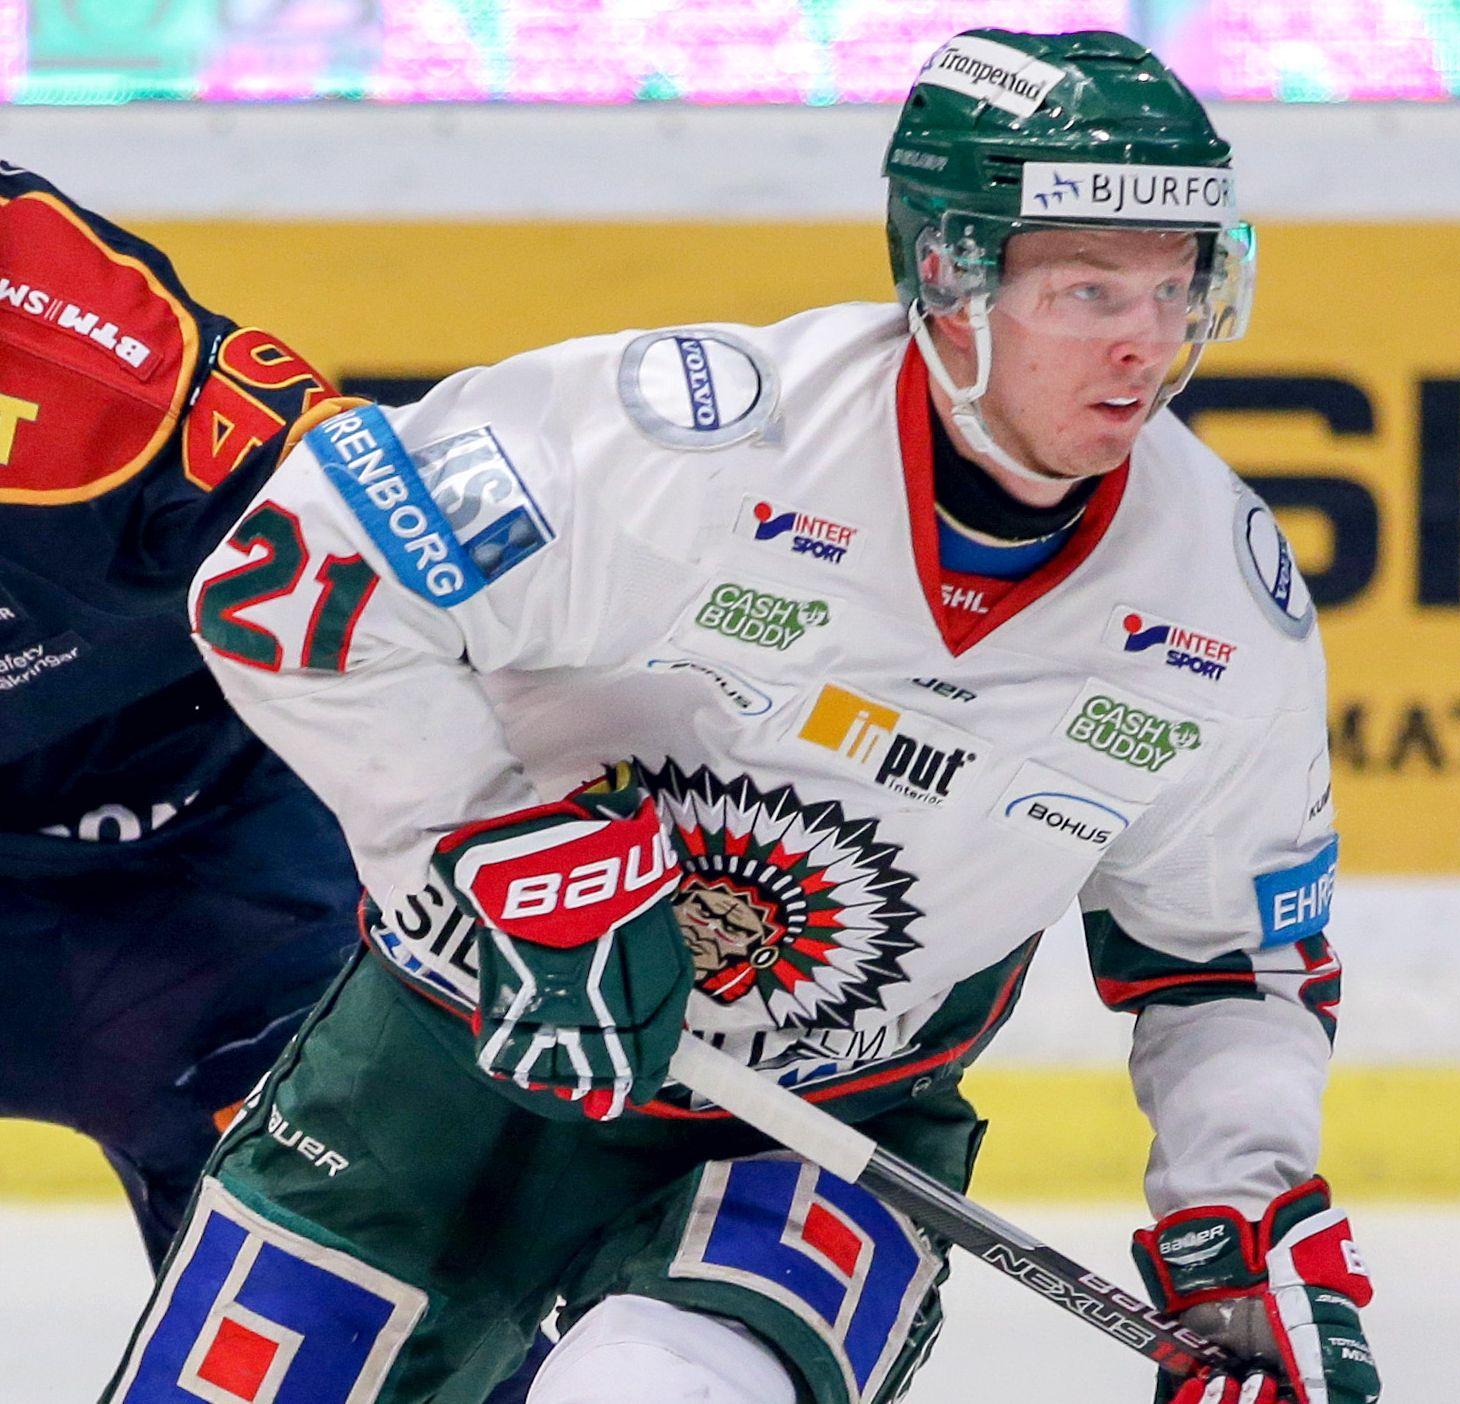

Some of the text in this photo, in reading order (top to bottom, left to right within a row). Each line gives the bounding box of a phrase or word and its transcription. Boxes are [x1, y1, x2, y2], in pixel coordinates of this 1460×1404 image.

[681, 338, 716, 427] VOLVO
[791, 535, 848, 565] SPORT
[794, 512, 855, 546] INTER
[195, 499, 382, 673] 21
[714, 585, 795, 624] CASH
[940, 583, 989, 614] SHL
[699, 604, 804, 650] BUDDY
[1169, 627, 1233, 662] INTER
[1165, 649, 1227, 682] SPORT
[1085, 697, 1167, 744] CASH
[840, 710, 967, 798] input
[1069, 718, 1176, 771] BUDDY
[1027, 802, 1112, 844] BOHUS
[982, 1243, 1157, 1349] NEXUS
